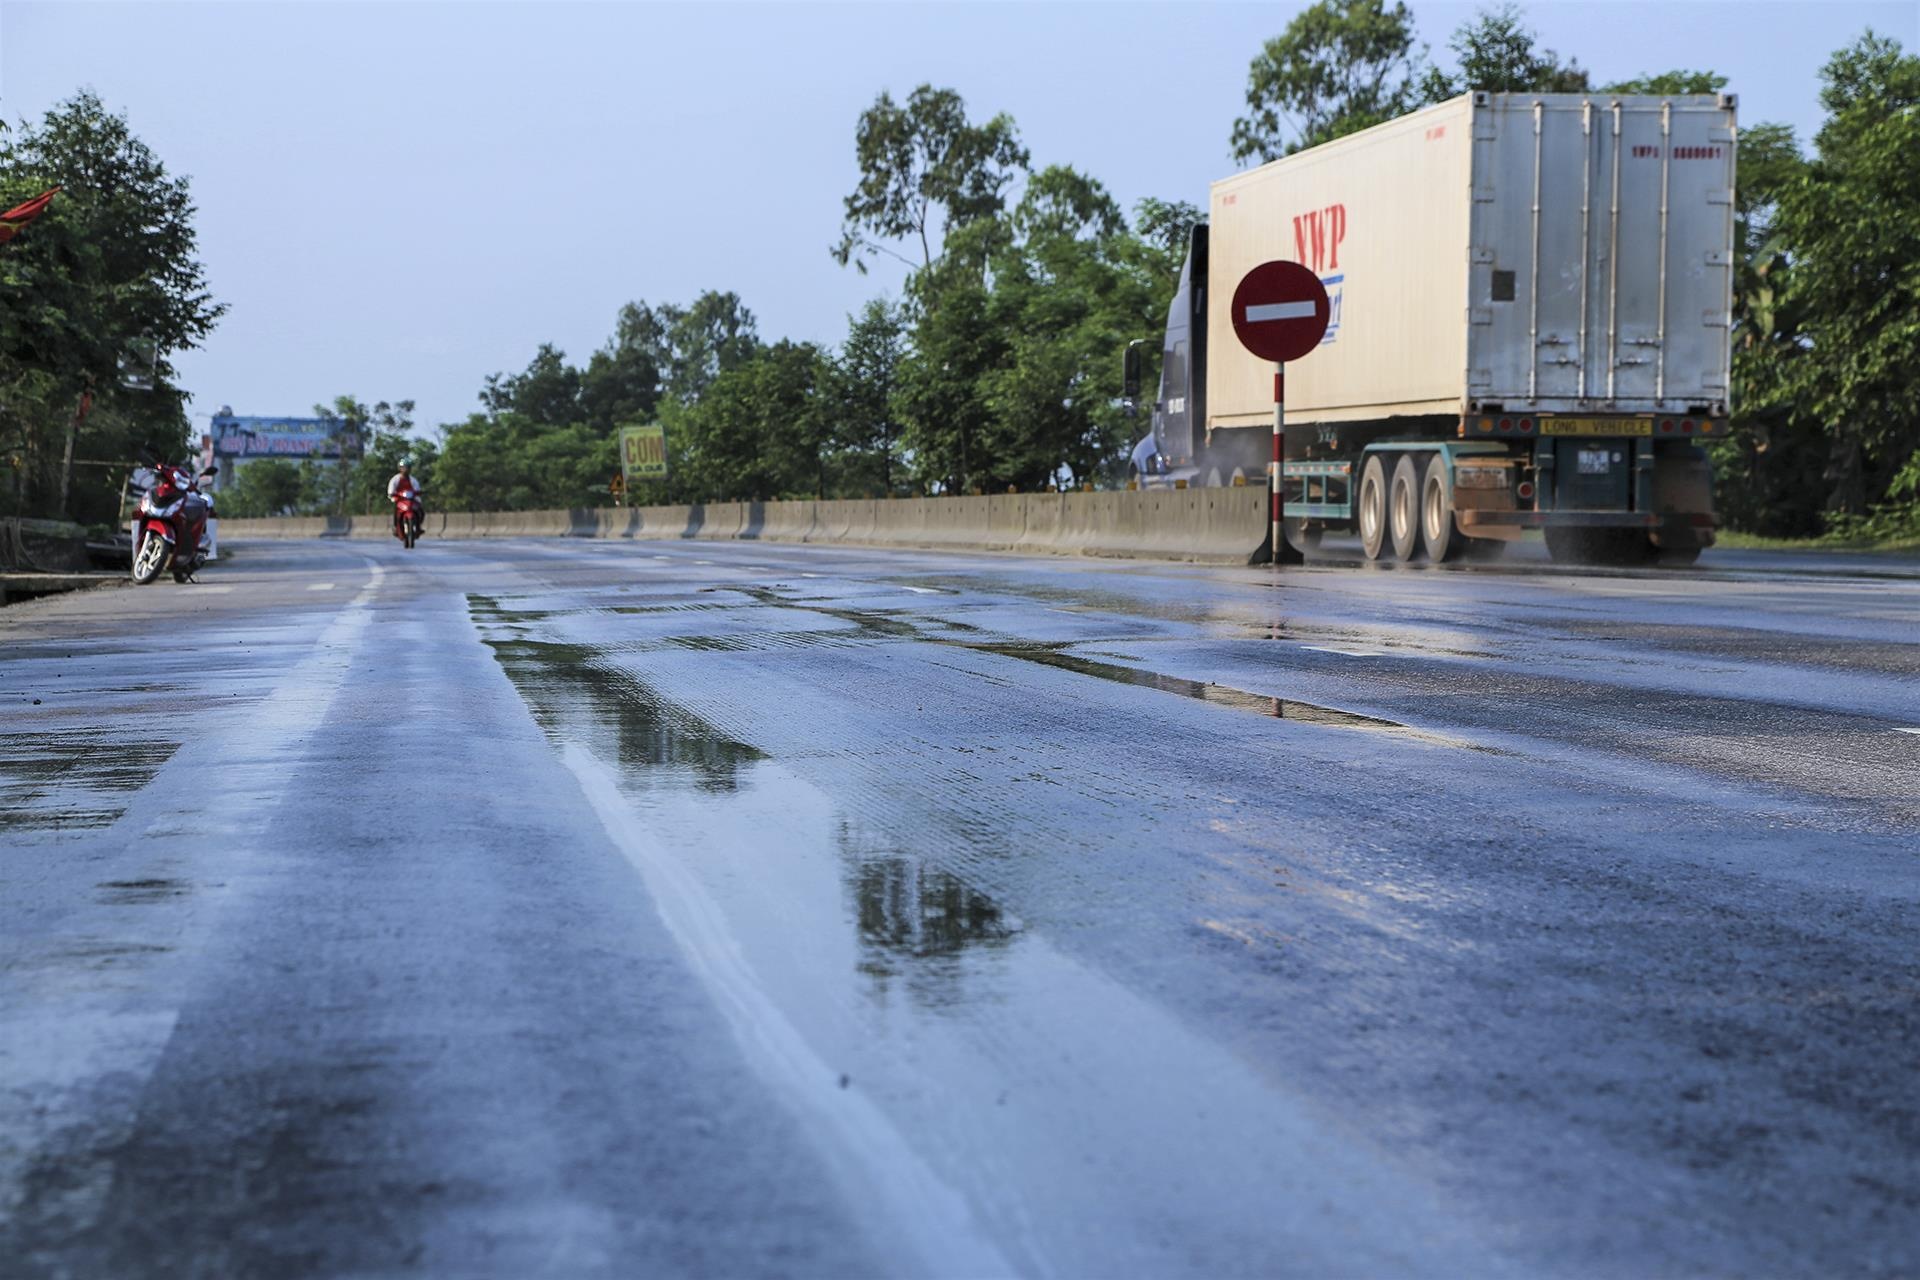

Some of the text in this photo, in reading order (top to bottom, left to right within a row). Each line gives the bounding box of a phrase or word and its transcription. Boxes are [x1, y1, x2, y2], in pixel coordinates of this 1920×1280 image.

[1293, 203, 1346, 272] NWP
[1544, 420, 1649, 434] LONG VEHICLE
